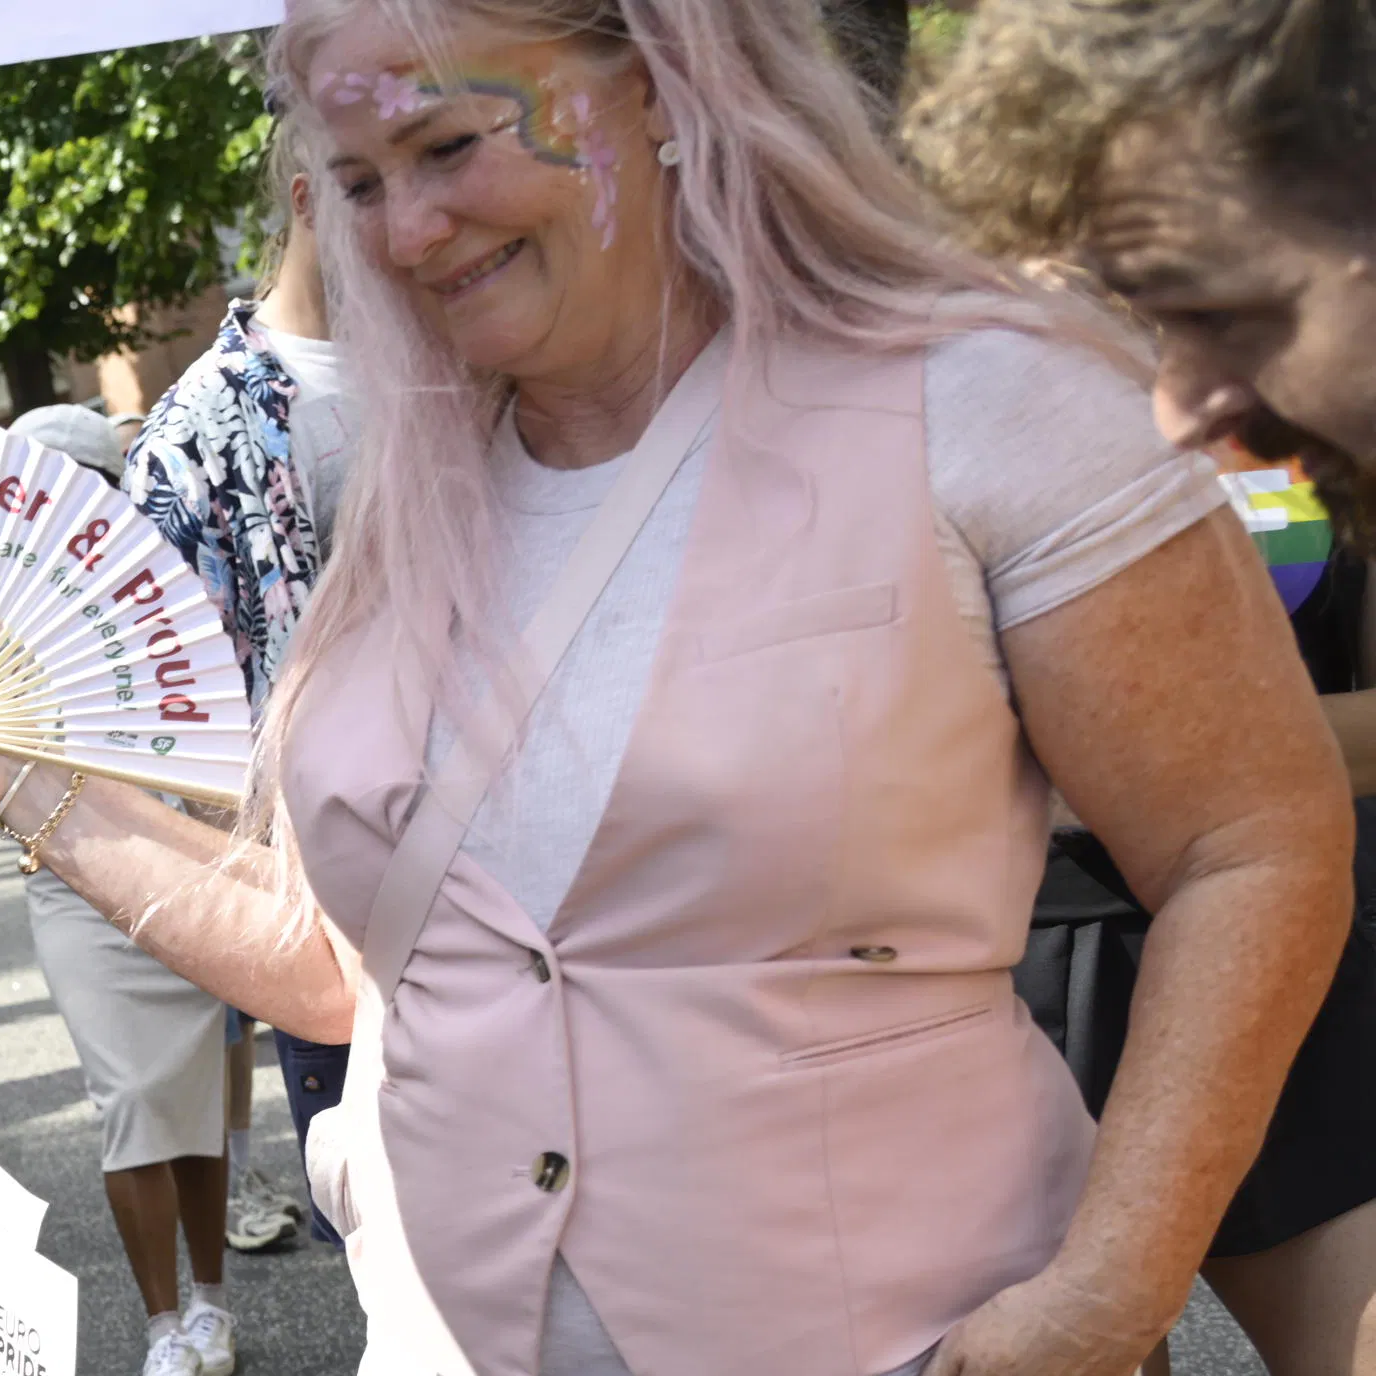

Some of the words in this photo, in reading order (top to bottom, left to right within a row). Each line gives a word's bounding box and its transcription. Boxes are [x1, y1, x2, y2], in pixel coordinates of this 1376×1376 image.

[0, 541, 38, 568] are
[66, 518, 111, 572] &
[111, 568, 210, 723] Proud
